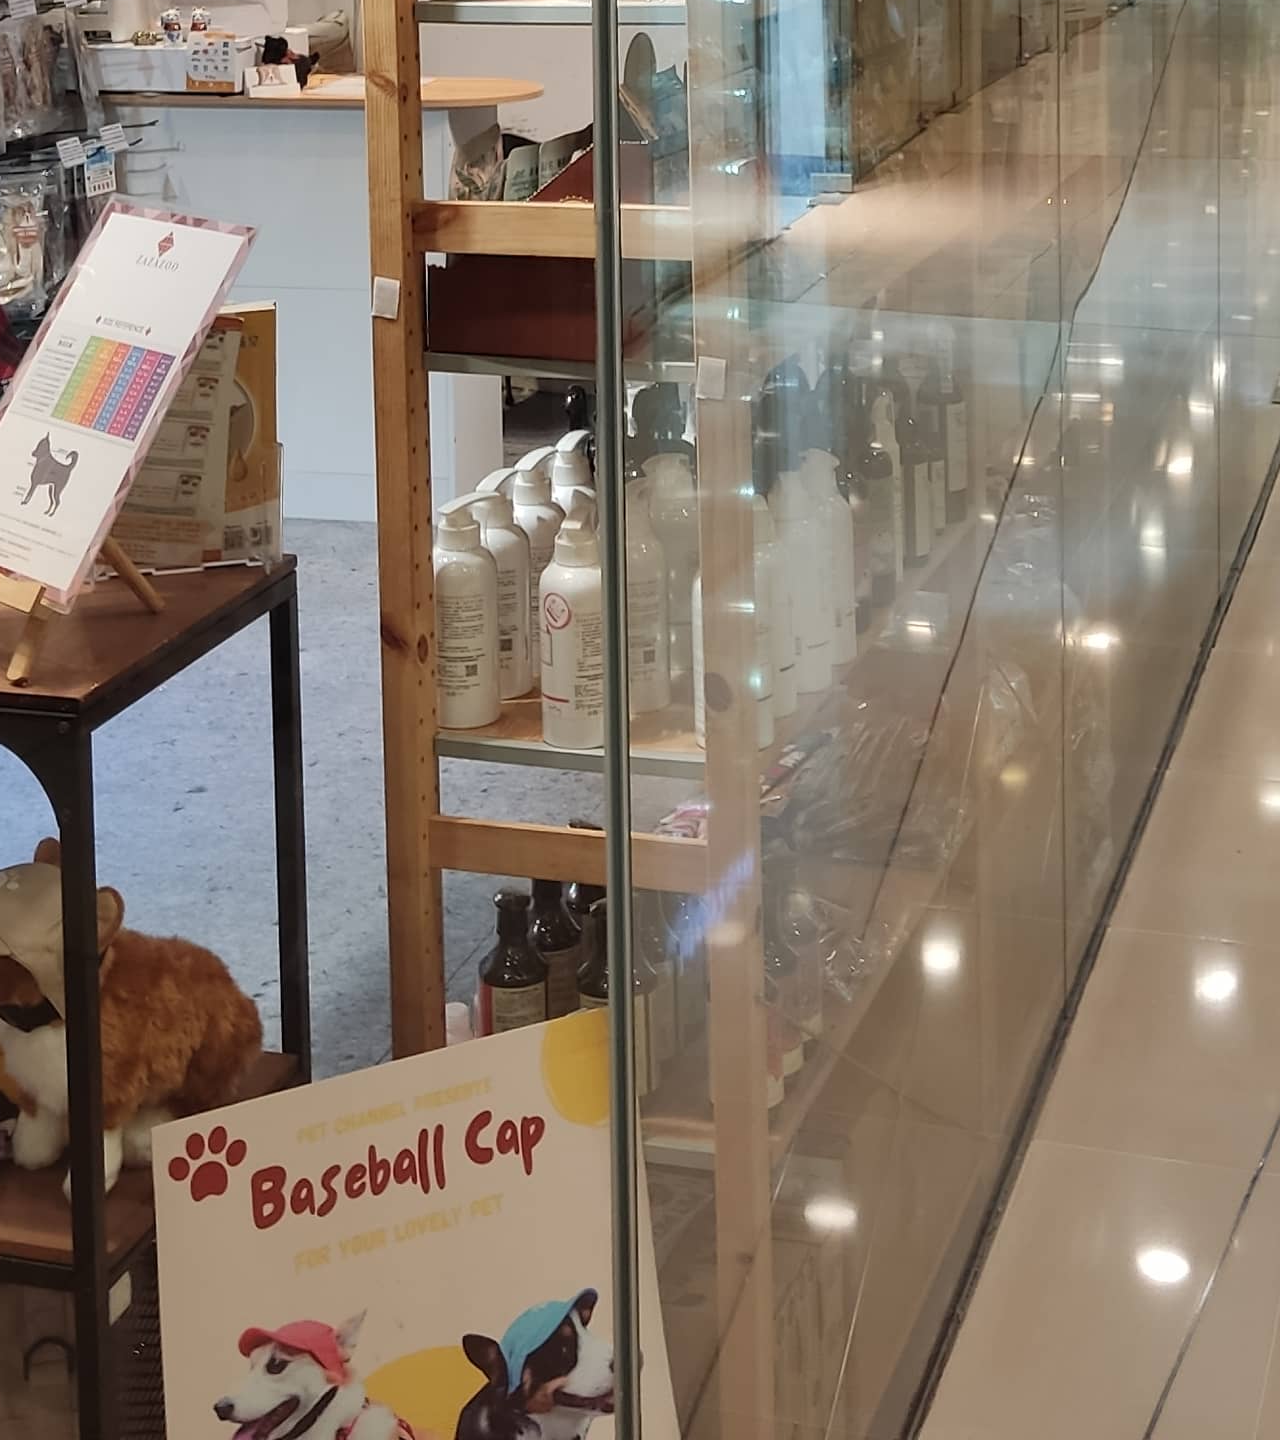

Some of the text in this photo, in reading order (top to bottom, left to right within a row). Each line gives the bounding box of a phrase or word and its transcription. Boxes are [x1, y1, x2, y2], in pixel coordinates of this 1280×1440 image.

[250, 1109, 546, 1231] Baseball Cap
[293, 1191, 505, 1277] FOR YOUR LOVELY PET
